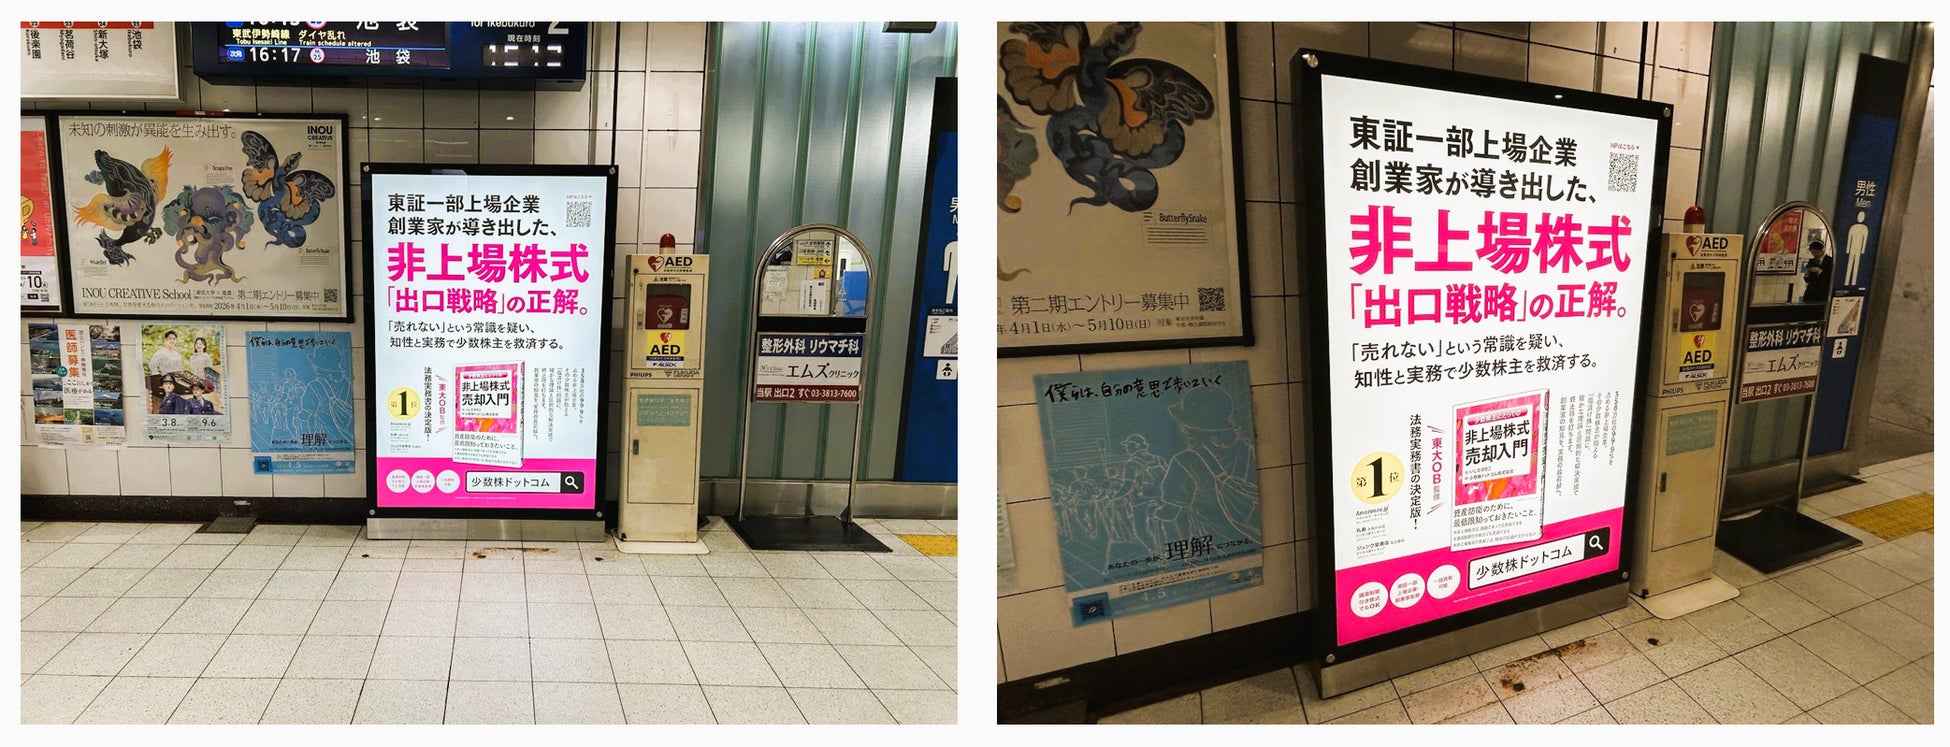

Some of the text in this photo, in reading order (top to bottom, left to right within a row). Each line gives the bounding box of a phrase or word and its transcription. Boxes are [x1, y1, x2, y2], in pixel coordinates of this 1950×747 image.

[132, 30, 142, 50] 池袋
[298, 30, 346, 40] ダイヤ乱れ
[507, 34, 541, 42] 現在時刻
[30, 30, 41, 59] 後楽園
[65, 30, 74, 60] 茗荷谷
[98, 30, 109, 59] 新大塚
[250, 48, 300, 62] 16:17
[68, 122, 236, 140] 未知の刺激が異能を生み出す。
[307, 125, 332, 135] INOU
[1349, 114, 1578, 167] 東証一部上場企業
[1350, 158, 1598, 204] 創業家が導き出した、
[1855, 180, 1876, 196] 男性
[388, 194, 540, 214] 東証一部上場企業
[1855, 198, 1871, 208] Men
[1159, 212, 1208, 225] ButterflySnake
[388, 217, 558, 237] 創業家が導き出した、
[1348, 205, 1632, 275] 非上場株式
[1702, 236, 1729, 250] AED
[388, 242, 590, 283] 非上場株式
[665, 256, 693, 267] AED
[82, 288, 106, 298] INOU
[108, 288, 160, 299] CREATIVE
[162, 288, 192, 300] School
[237, 290, 320, 302] 第二期エントリー募集中
[388, 286, 588, 316] 「出口戦略」の正解。
[1012, 293, 1190, 314] 第二期エントリー募集中
[1350, 281, 1626, 328] 「出口戦略」の正解。
[388, 320, 536, 334] 「売れない」という常識を疑い、
[390, 336, 564, 350] 知性と実務で少数株主を救済する。
[761, 338, 860, 354] 整形外科 リウマチ科
[1749, 327, 1821, 349] 整形外科 リウマチ科
[65, 329, 80, 378] 医師募集
[650, 344, 680, 355] AED
[1352, 333, 1564, 362] 「売れない」という常識を疑い、
[1683, 350, 1712, 364] AED
[786, 362, 860, 378] エムズクリニック
[1354, 352, 1598, 389] 知性と実務で少数株主を救済する。
[462, 380, 510, 392] 非上場株式
[756, 387, 857, 398] 当駅 出口2 すぐ 03-3813-7600
[1662, 387, 1684, 395] PHILIPS
[1742, 386, 1754, 398] 当駅
[1755, 385, 1771, 396] 出口2
[1774, 383, 1781, 394] すぐ
[462, 393, 510, 406] 売却入門
[300, 433, 328, 446] 理解
[1465, 420, 1530, 445] 非上場株式
[1465, 438, 1529, 466] 売却入門
[1410, 414, 1422, 530] 法務実務書の決定版！
[472, 477, 550, 488] 少数株ドットコム
[1475, 545, 1572, 581] 少数株ドットコム
